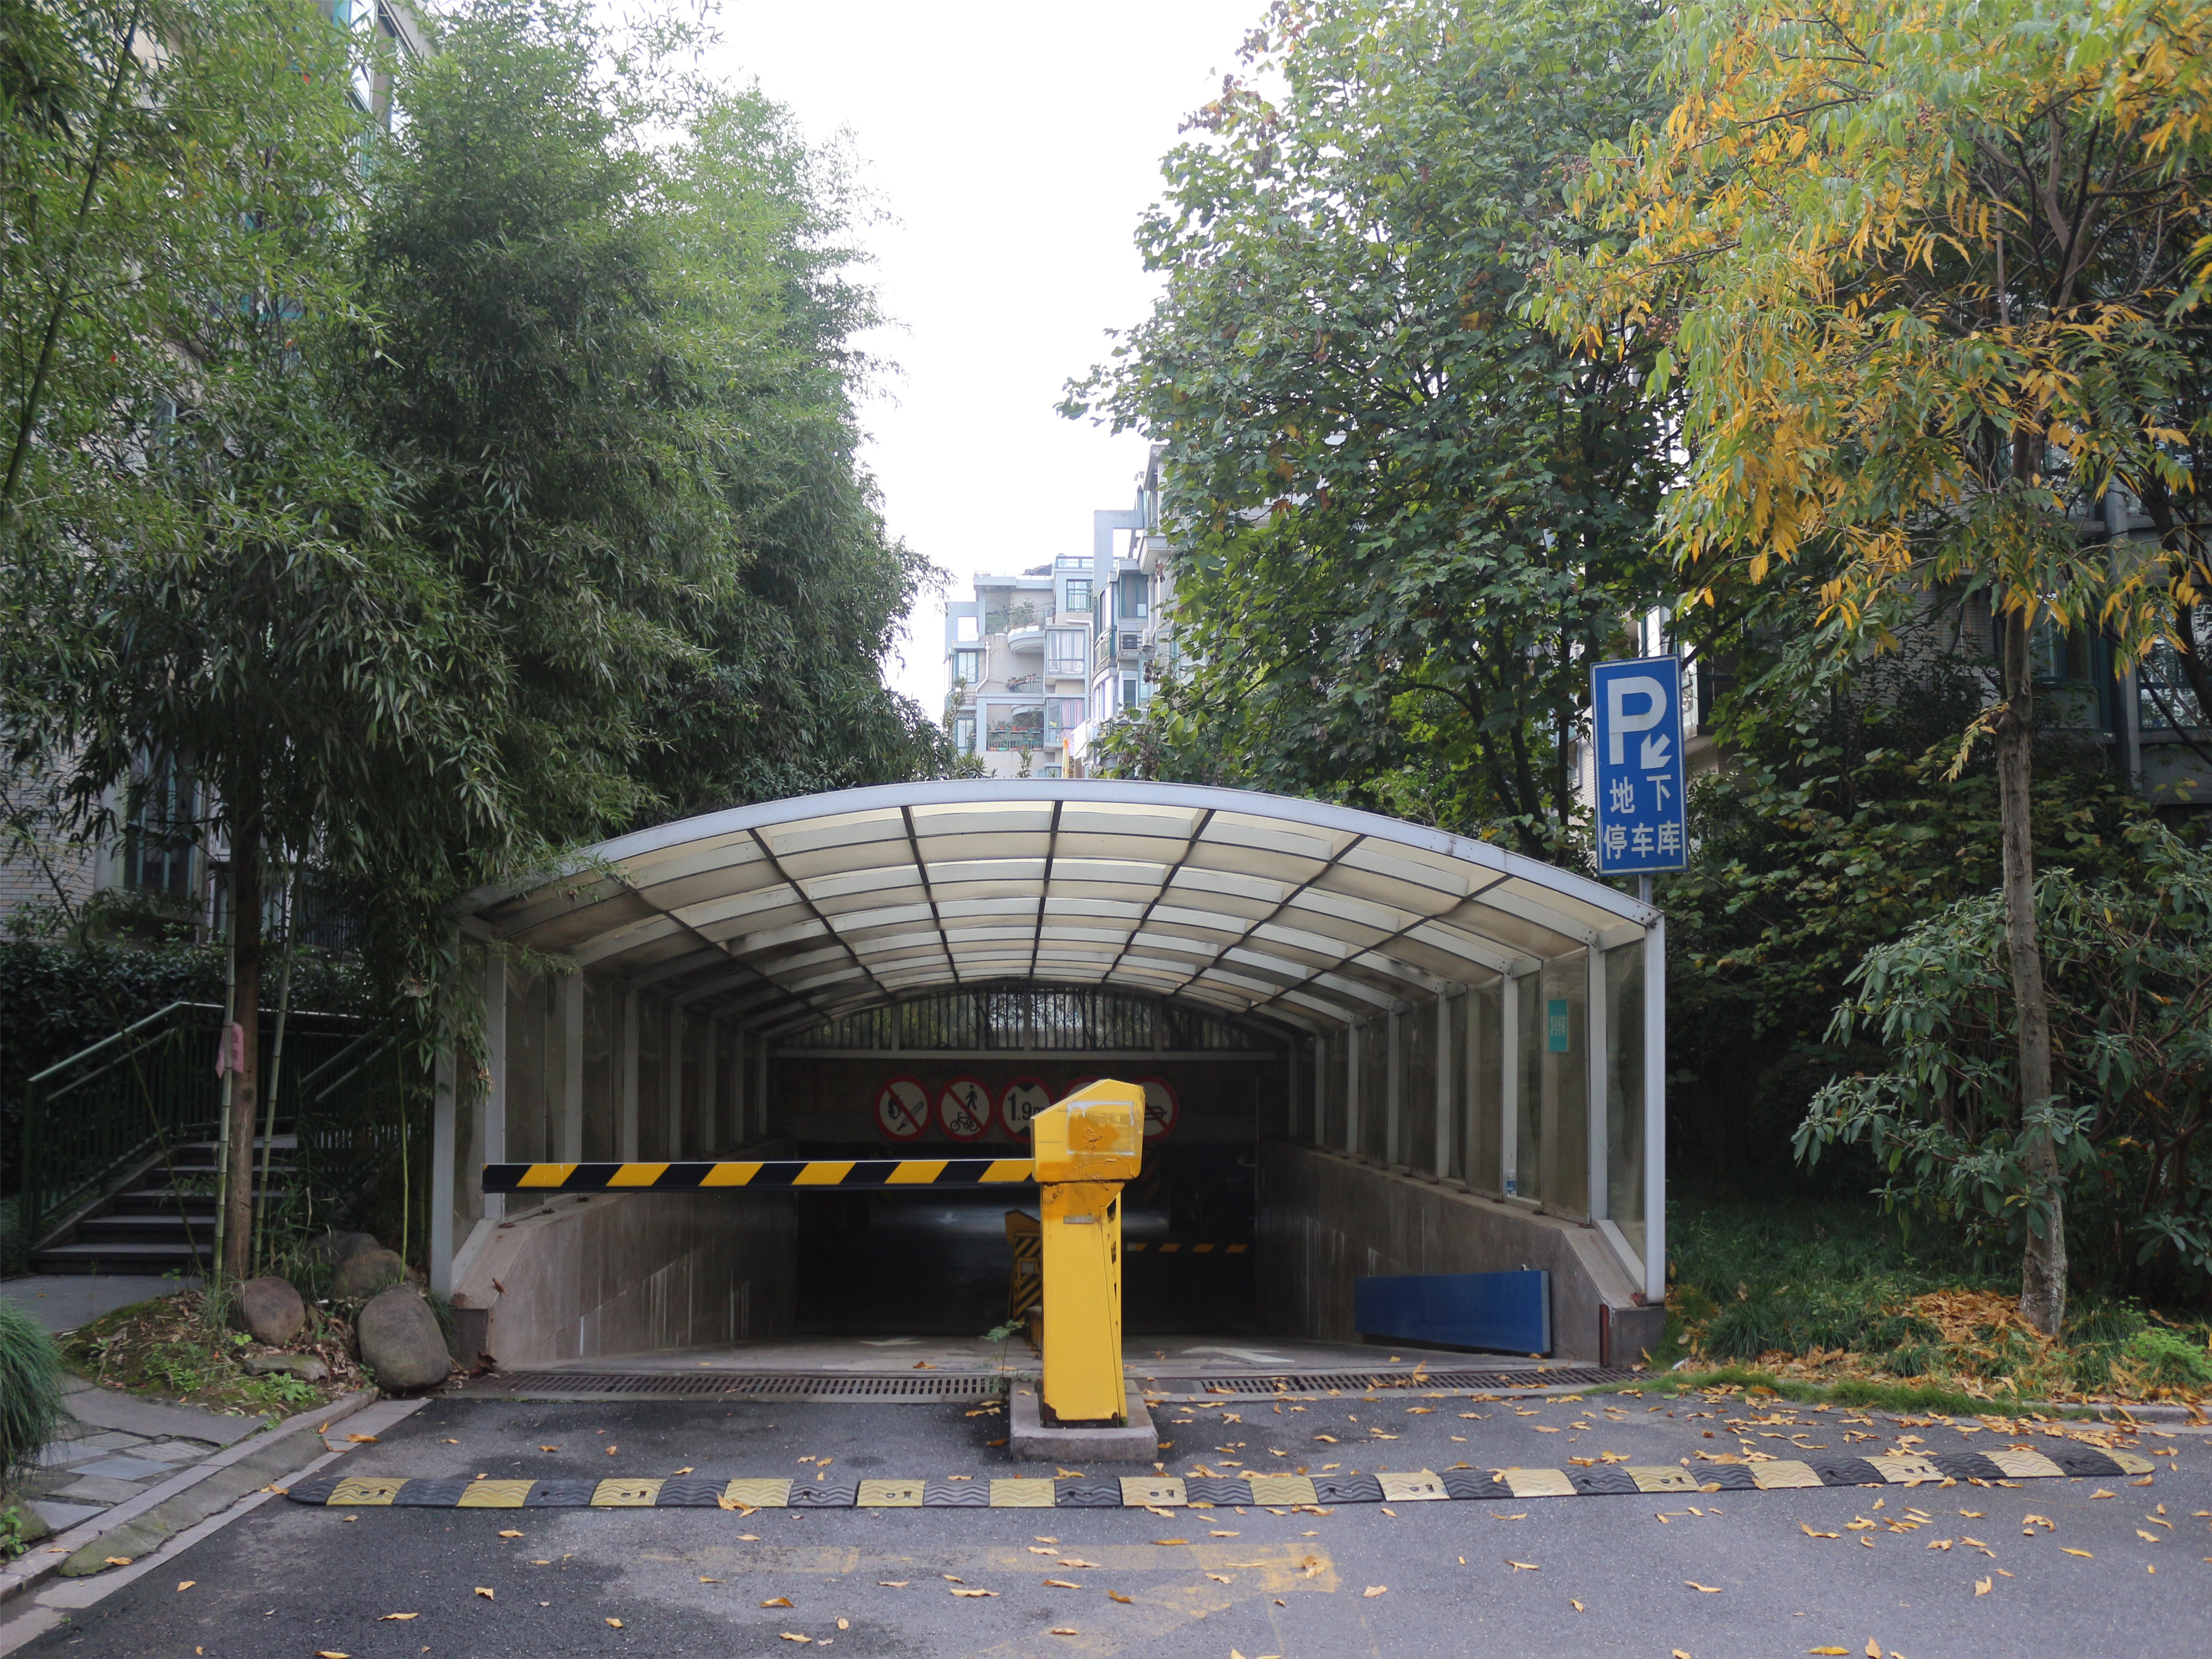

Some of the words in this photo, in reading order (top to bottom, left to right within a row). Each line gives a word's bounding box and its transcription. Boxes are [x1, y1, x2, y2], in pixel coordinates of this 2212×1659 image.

[1608, 676, 1667, 765] P
[1610, 775, 1671, 814] 地下
[1604, 820, 1681, 859] 停车库
